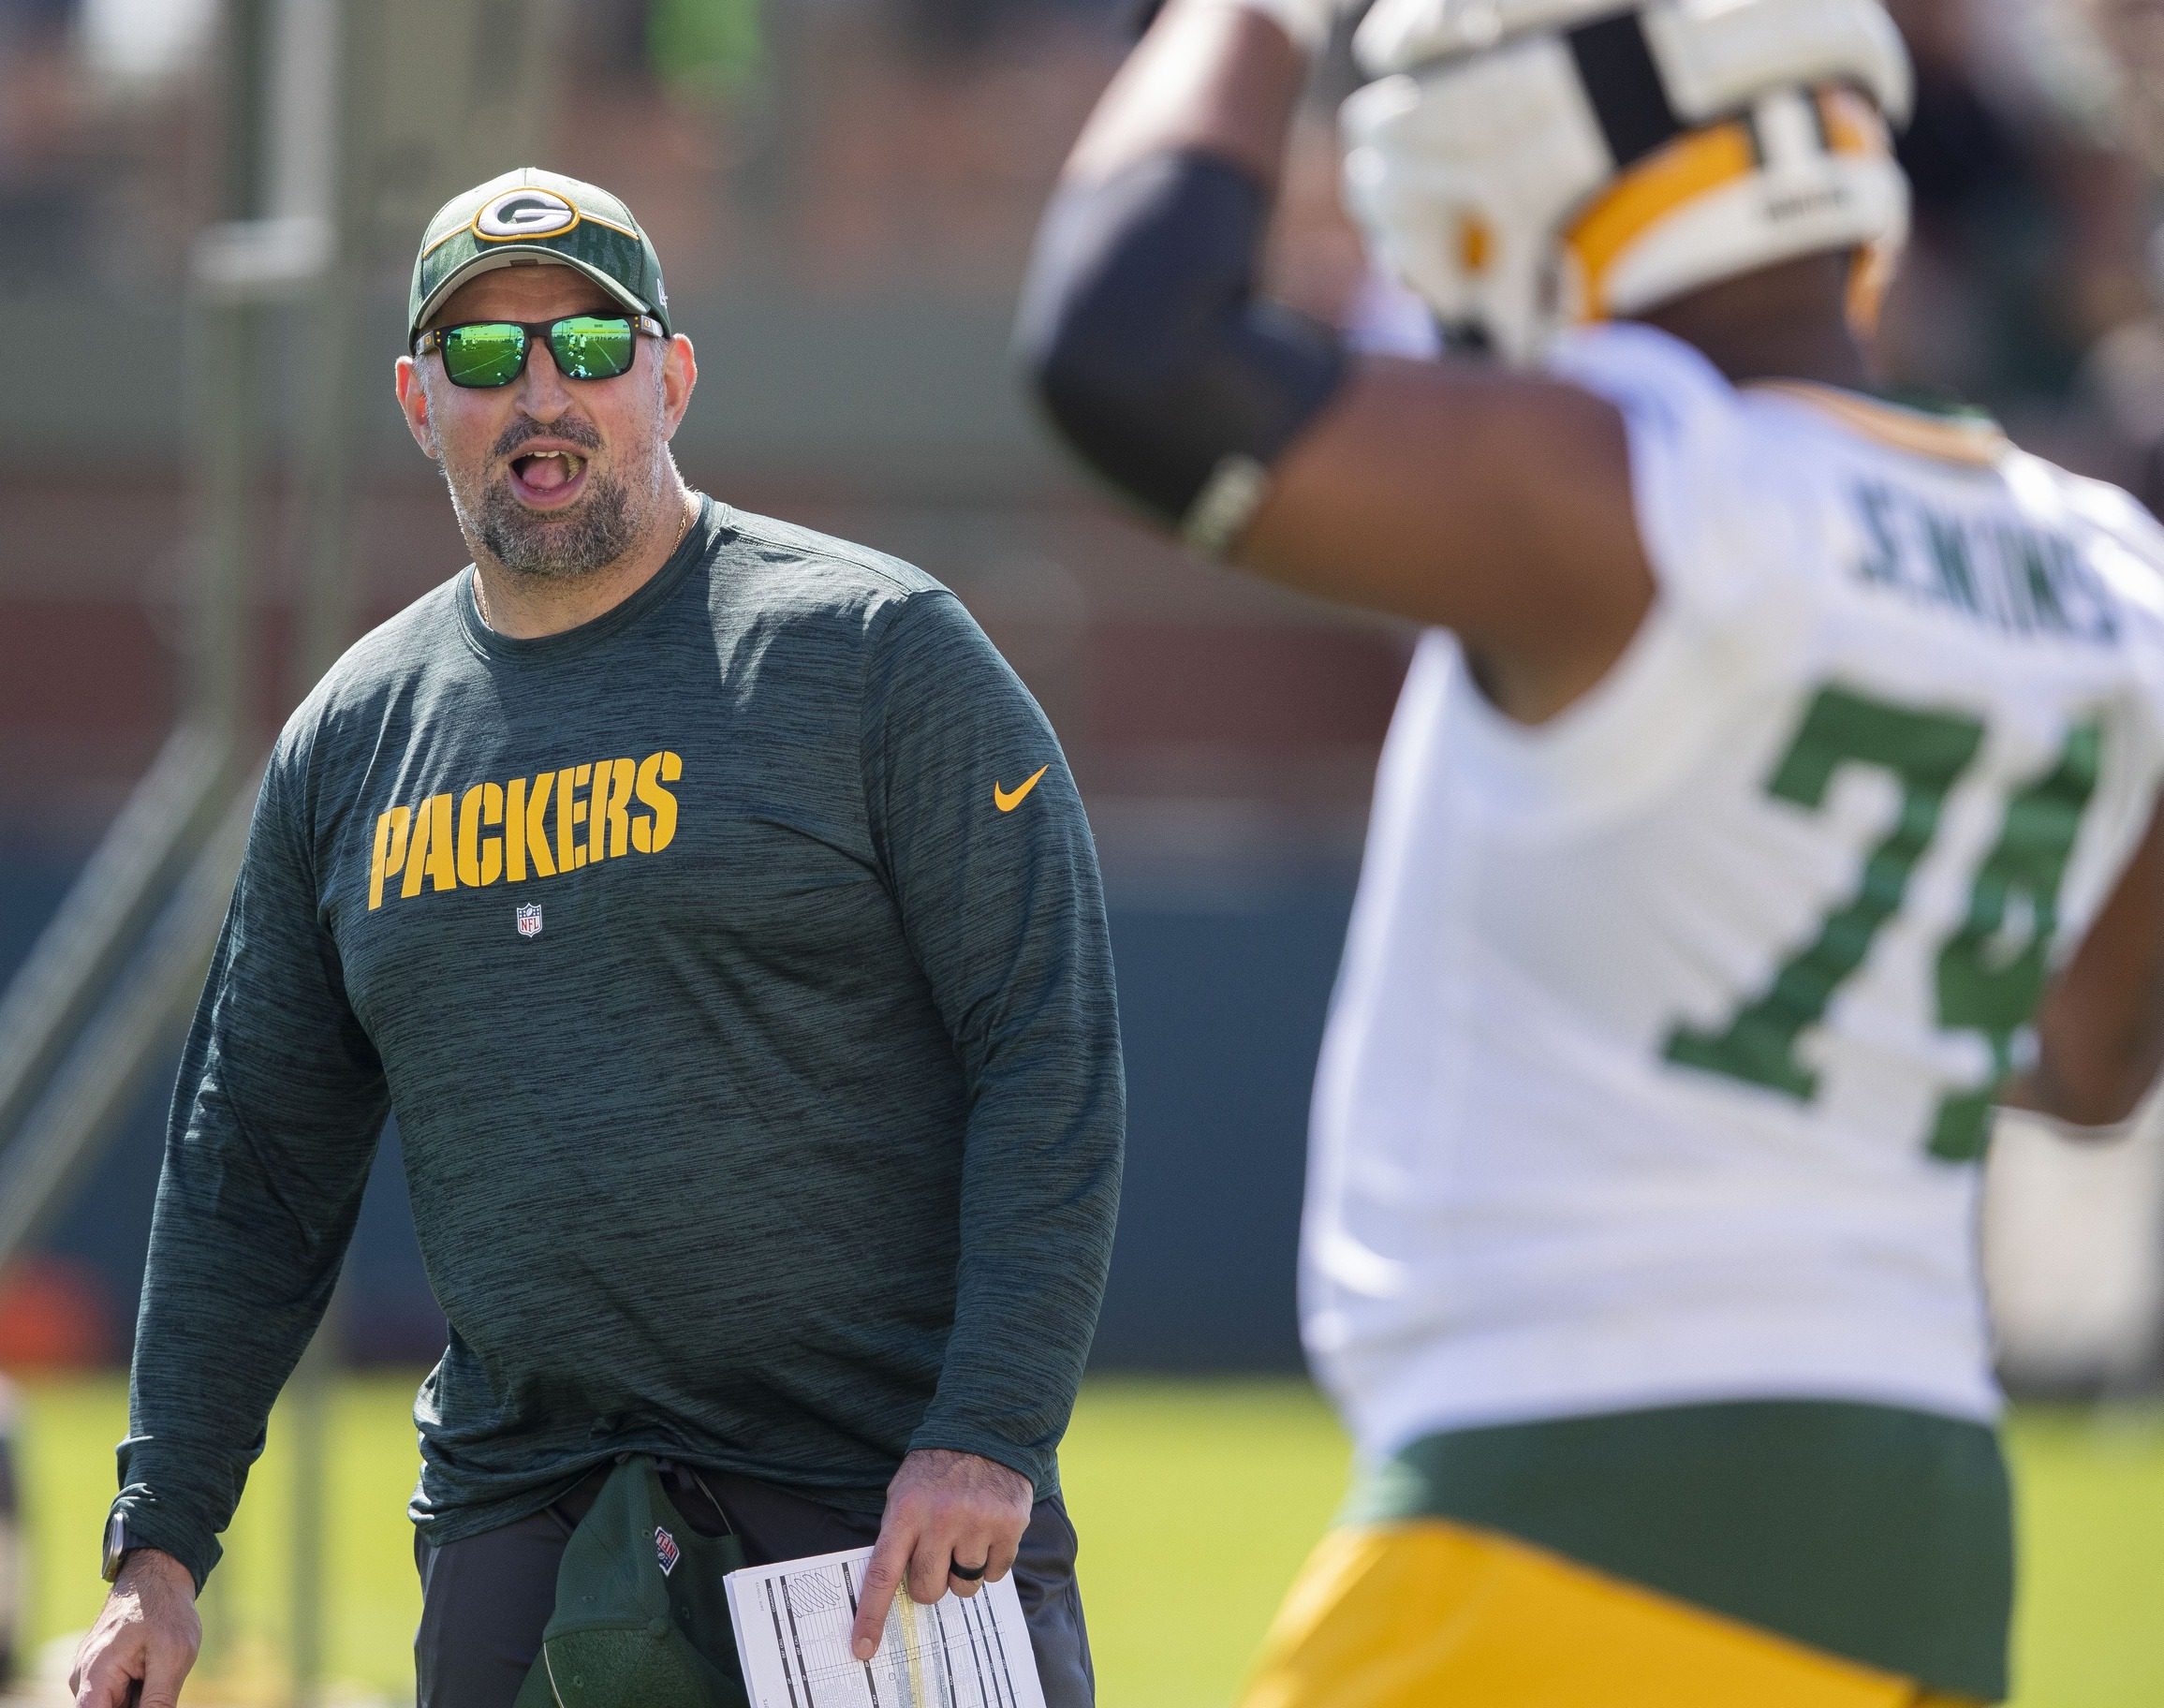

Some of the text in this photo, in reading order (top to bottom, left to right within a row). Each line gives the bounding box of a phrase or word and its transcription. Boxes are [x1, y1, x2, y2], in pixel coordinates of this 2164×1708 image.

[477, 190, 573, 236] G
[368, 751, 683, 911] PACKERS
[521, 918, 539, 932] NFL
[1659, 682, 2102, 1164] 74
[782, 1583, 790, 1609] COMMENTS
[844, 1570, 853, 1596] COMMENTS
[767, 1587, 775, 1612] COMMENTS
